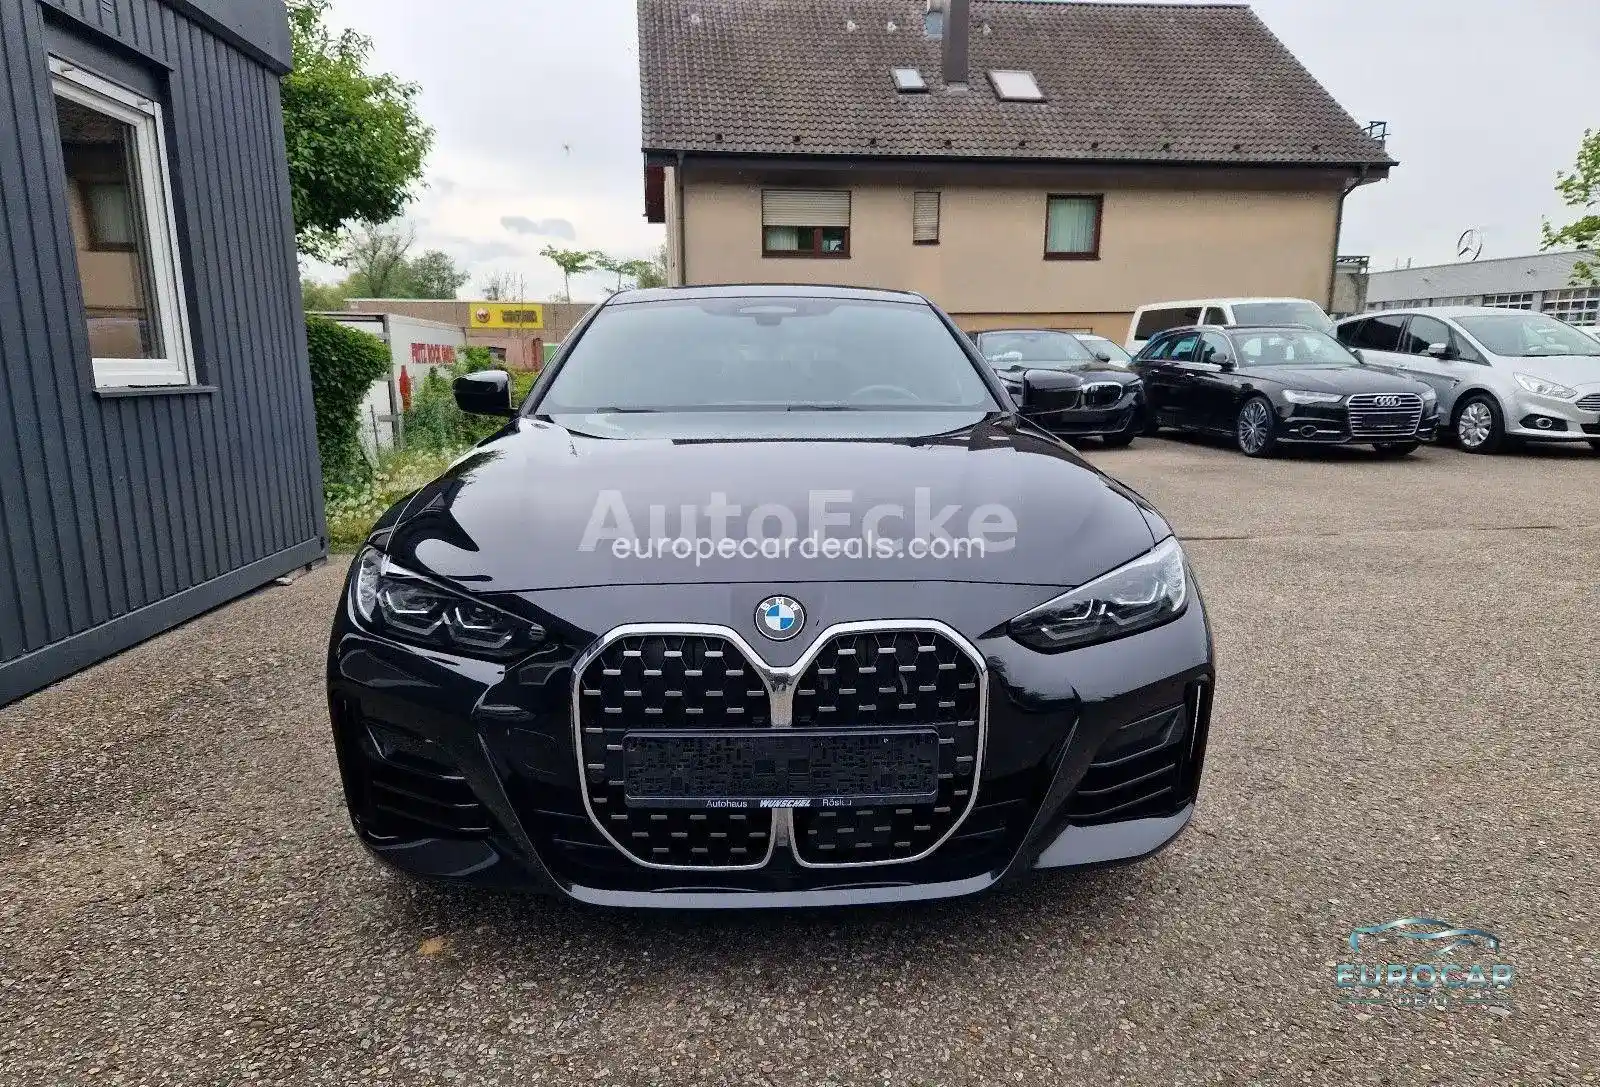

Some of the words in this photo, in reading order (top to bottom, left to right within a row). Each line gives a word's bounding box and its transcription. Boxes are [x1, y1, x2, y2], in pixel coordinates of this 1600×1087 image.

[760, 598, 800, 611] BMW
[705, 798, 748, 808] Autohaus
[759, 798, 812, 808] WUNSCHEL
